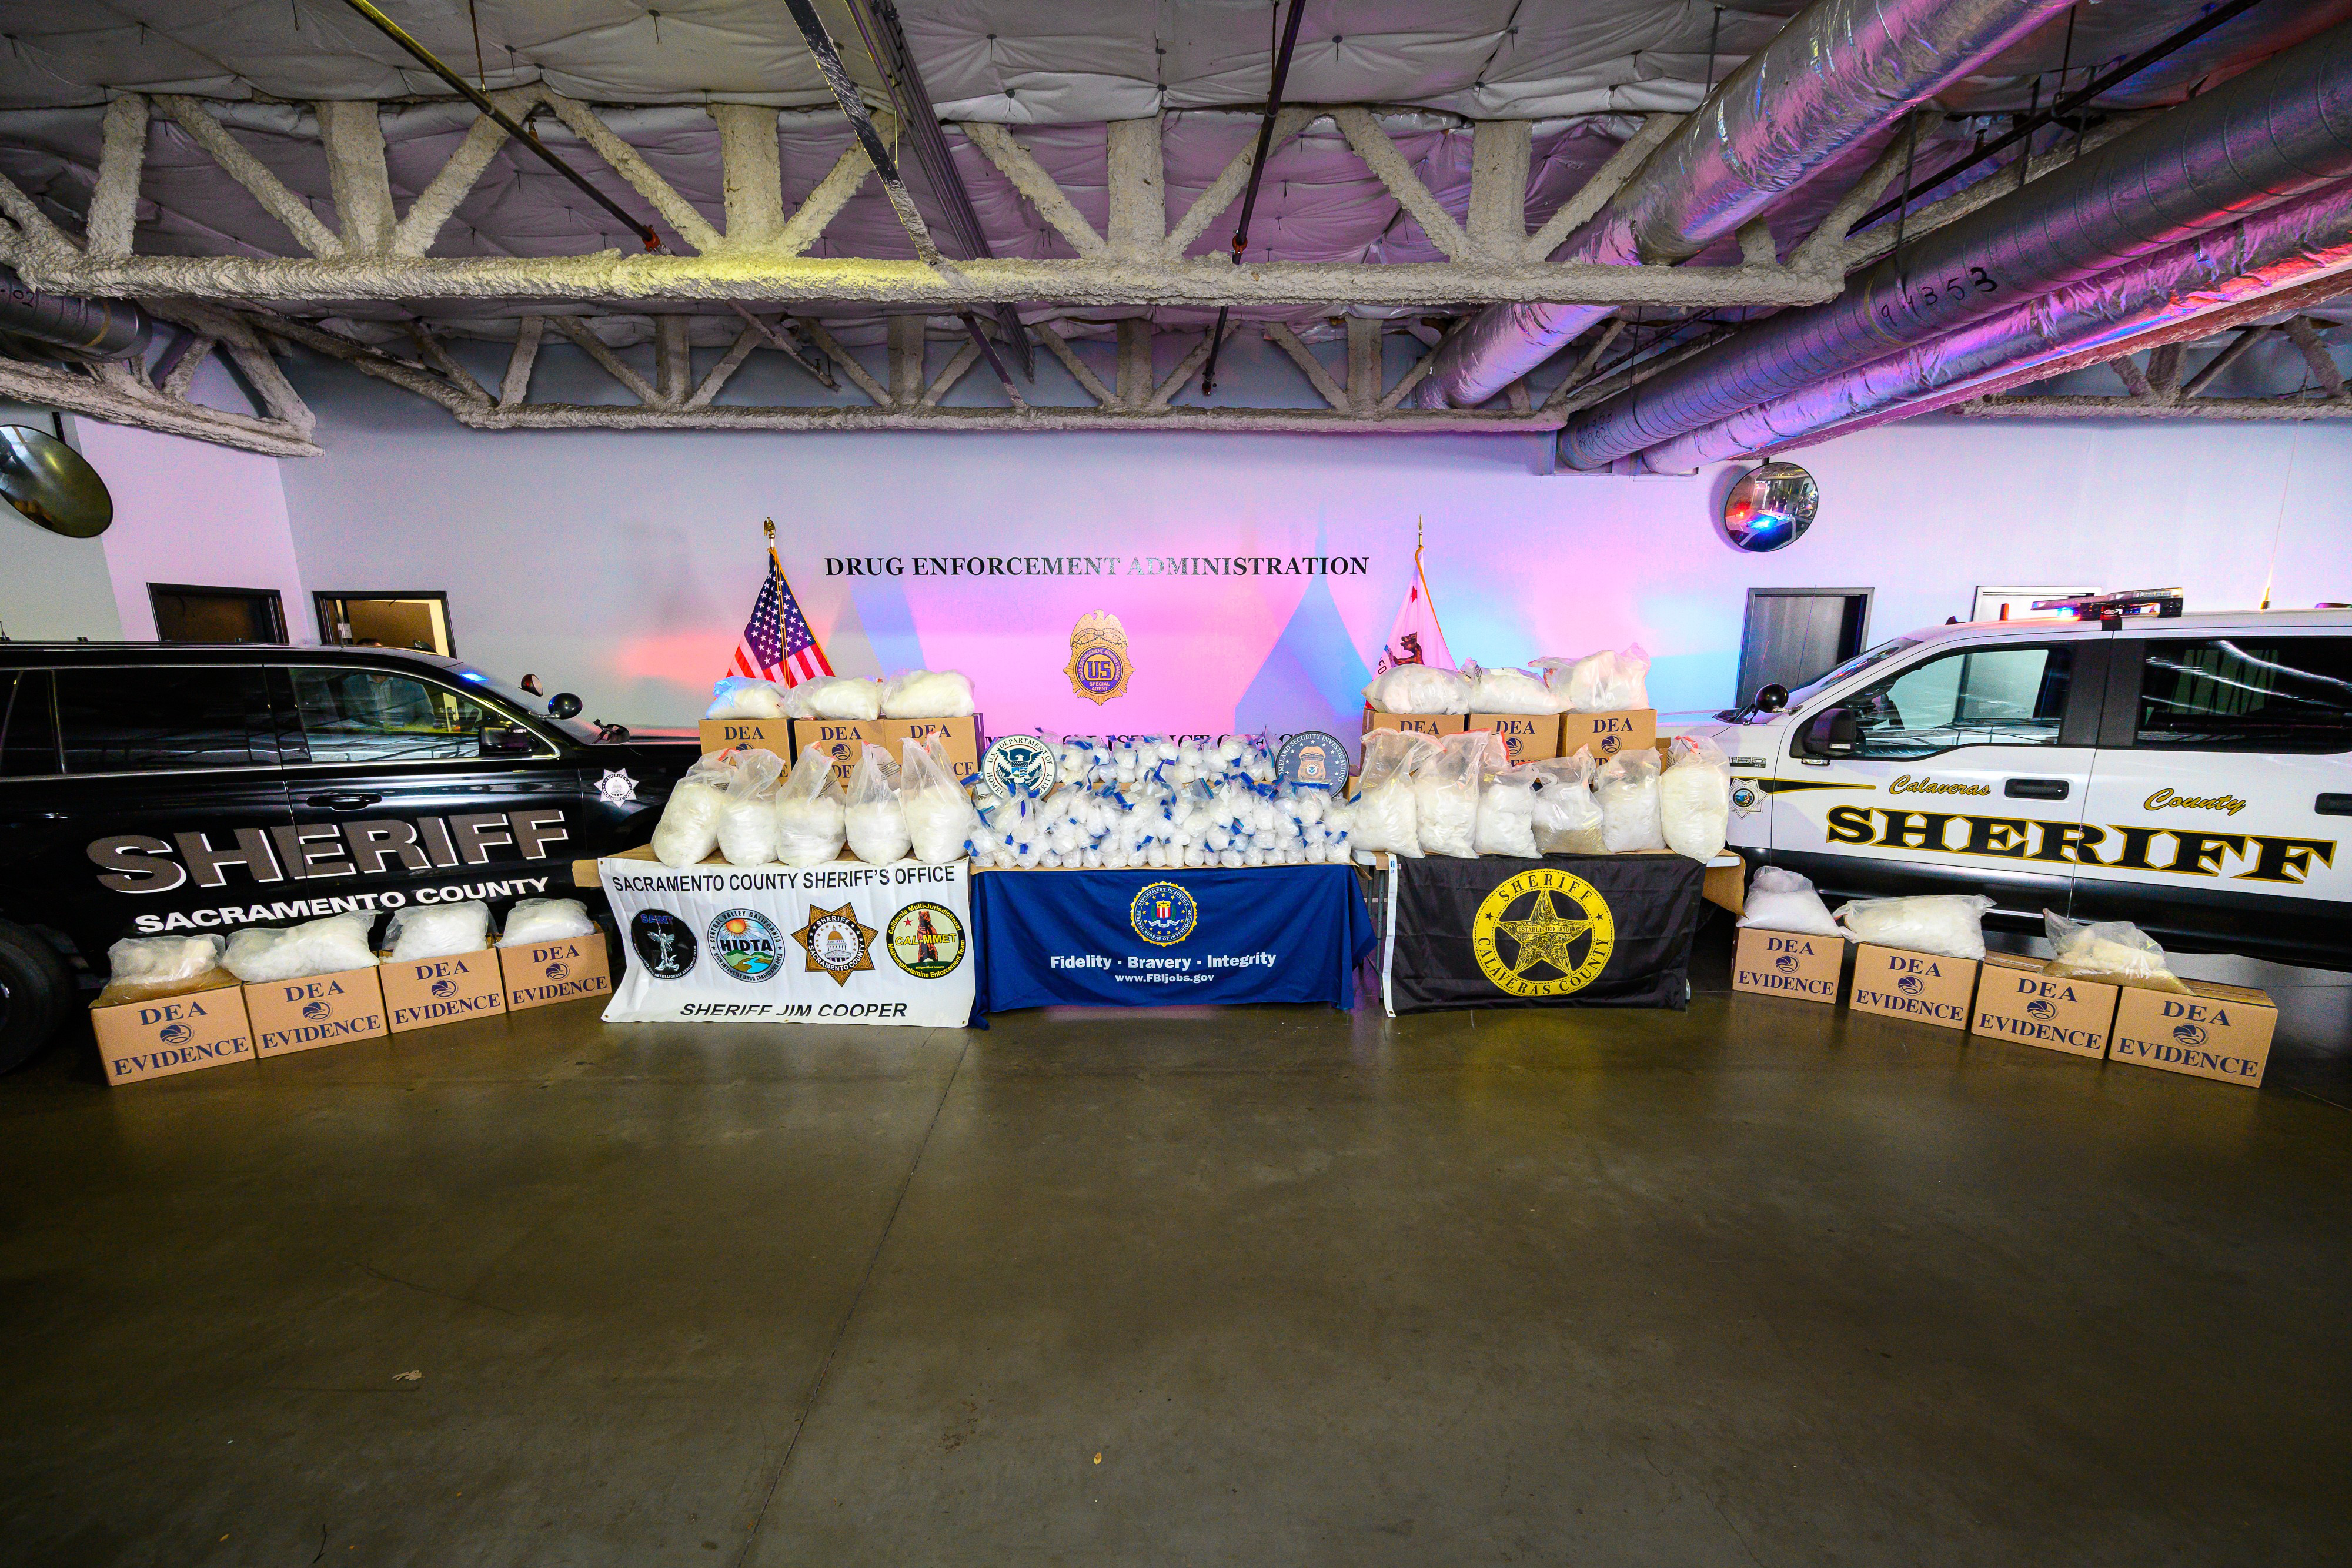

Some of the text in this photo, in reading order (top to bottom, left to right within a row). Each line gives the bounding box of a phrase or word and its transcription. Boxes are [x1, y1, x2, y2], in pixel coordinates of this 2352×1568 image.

[824, 557, 1369, 576] DRUG ENFORCEMENT ADMINISTRATION
[1079, 649, 1104, 667] ENFORCEMENT
[1104, 649, 1121, 681] ADMINISTRATION
[1087, 661, 1111, 679] US
[724, 726, 765, 740] DEA
[820, 726, 862, 740] DEA
[910, 724, 951, 738] DEA
[1399, 720, 1439, 735] DEA
[1496, 721, 1535, 734] DEA
[1592, 717, 1633, 733] DEA
[988, 752, 997, 763] U.S.
[999, 738, 1048, 755] DEPARTMENT
[1045, 755, 1053, 765] OF
[1290, 734, 1321, 747] SECURITY
[1321, 735, 1346, 783] INVESTIGATIONS
[1889, 774, 1991, 796] Calaveras
[2144, 788, 2246, 816] County
[86, 809, 569, 894] SHERIFF
[1826, 805, 2337, 885] SHERIFF
[612, 874, 724, 892] SACRAMENTO
[729, 873, 798, 890] COUNTY
[895, 866, 954, 884] OFFICE
[1499, 873, 1592, 902] SHERIFF
[135, 877, 549, 932] SACRAMENTO COUNTY
[1138, 888, 1166, 907] DEPARTMENT
[1174, 890, 1190, 907] JUSTICE
[710, 911, 781, 942] CENTRAL VALLEY CALIFORNIA
[817, 916, 850, 927] SHERIFF
[888, 903, 962, 934] California Multi-Jurisdictional
[1144, 931, 1161, 940] BUREAU
[1170, 909, 1191, 940] INVESTIGATION
[720, 939, 773, 951] HIDTA
[895, 933, 957, 946] CAL-MMET
[1766, 937, 1814, 955] DEA
[532, 944, 580, 963] DEA
[808, 944, 865, 971] SACRAMENTO COUNTY
[888, 943, 929, 978] Methamphetamine
[930, 955, 961, 978] Enforcement
[1050, 951, 1276, 971] Fidelity Bravery Integrity
[1478, 937, 1609, 995] CALAVERAS COUNTY
[1888, 955, 1942, 977] DEA
[415, 959, 470, 981] DEA
[713, 952, 722, 964] HIGH
[721, 962, 743, 978] INTENSITY
[756, 964, 779, 981] TRAFFICKING
[1115, 974, 1214, 984] www.FBIjobs.gov
[283, 980, 345, 1002] DEA
[512, 976, 607, 1005] EVIDENCE
[1738, 971, 1834, 995] EVIDENCE
[2016, 978, 2077, 1002] DEA
[138, 1001, 208, 1026] DEA
[394, 993, 501, 1024] EVIDENCE
[680, 1003, 907, 1017] SHERIFF JIM COOPER
[1856, 989, 1963, 1021] EVIDENCE
[2161, 1000, 2231, 1027] DEA
[260, 1015, 381, 1049] EVIDENCE
[1979, 1013, 2102, 1050] EVIDENCE
[113, 1037, 249, 1076] EVIDENCE
[2117, 1037, 2259, 1078] EVIDENCE
